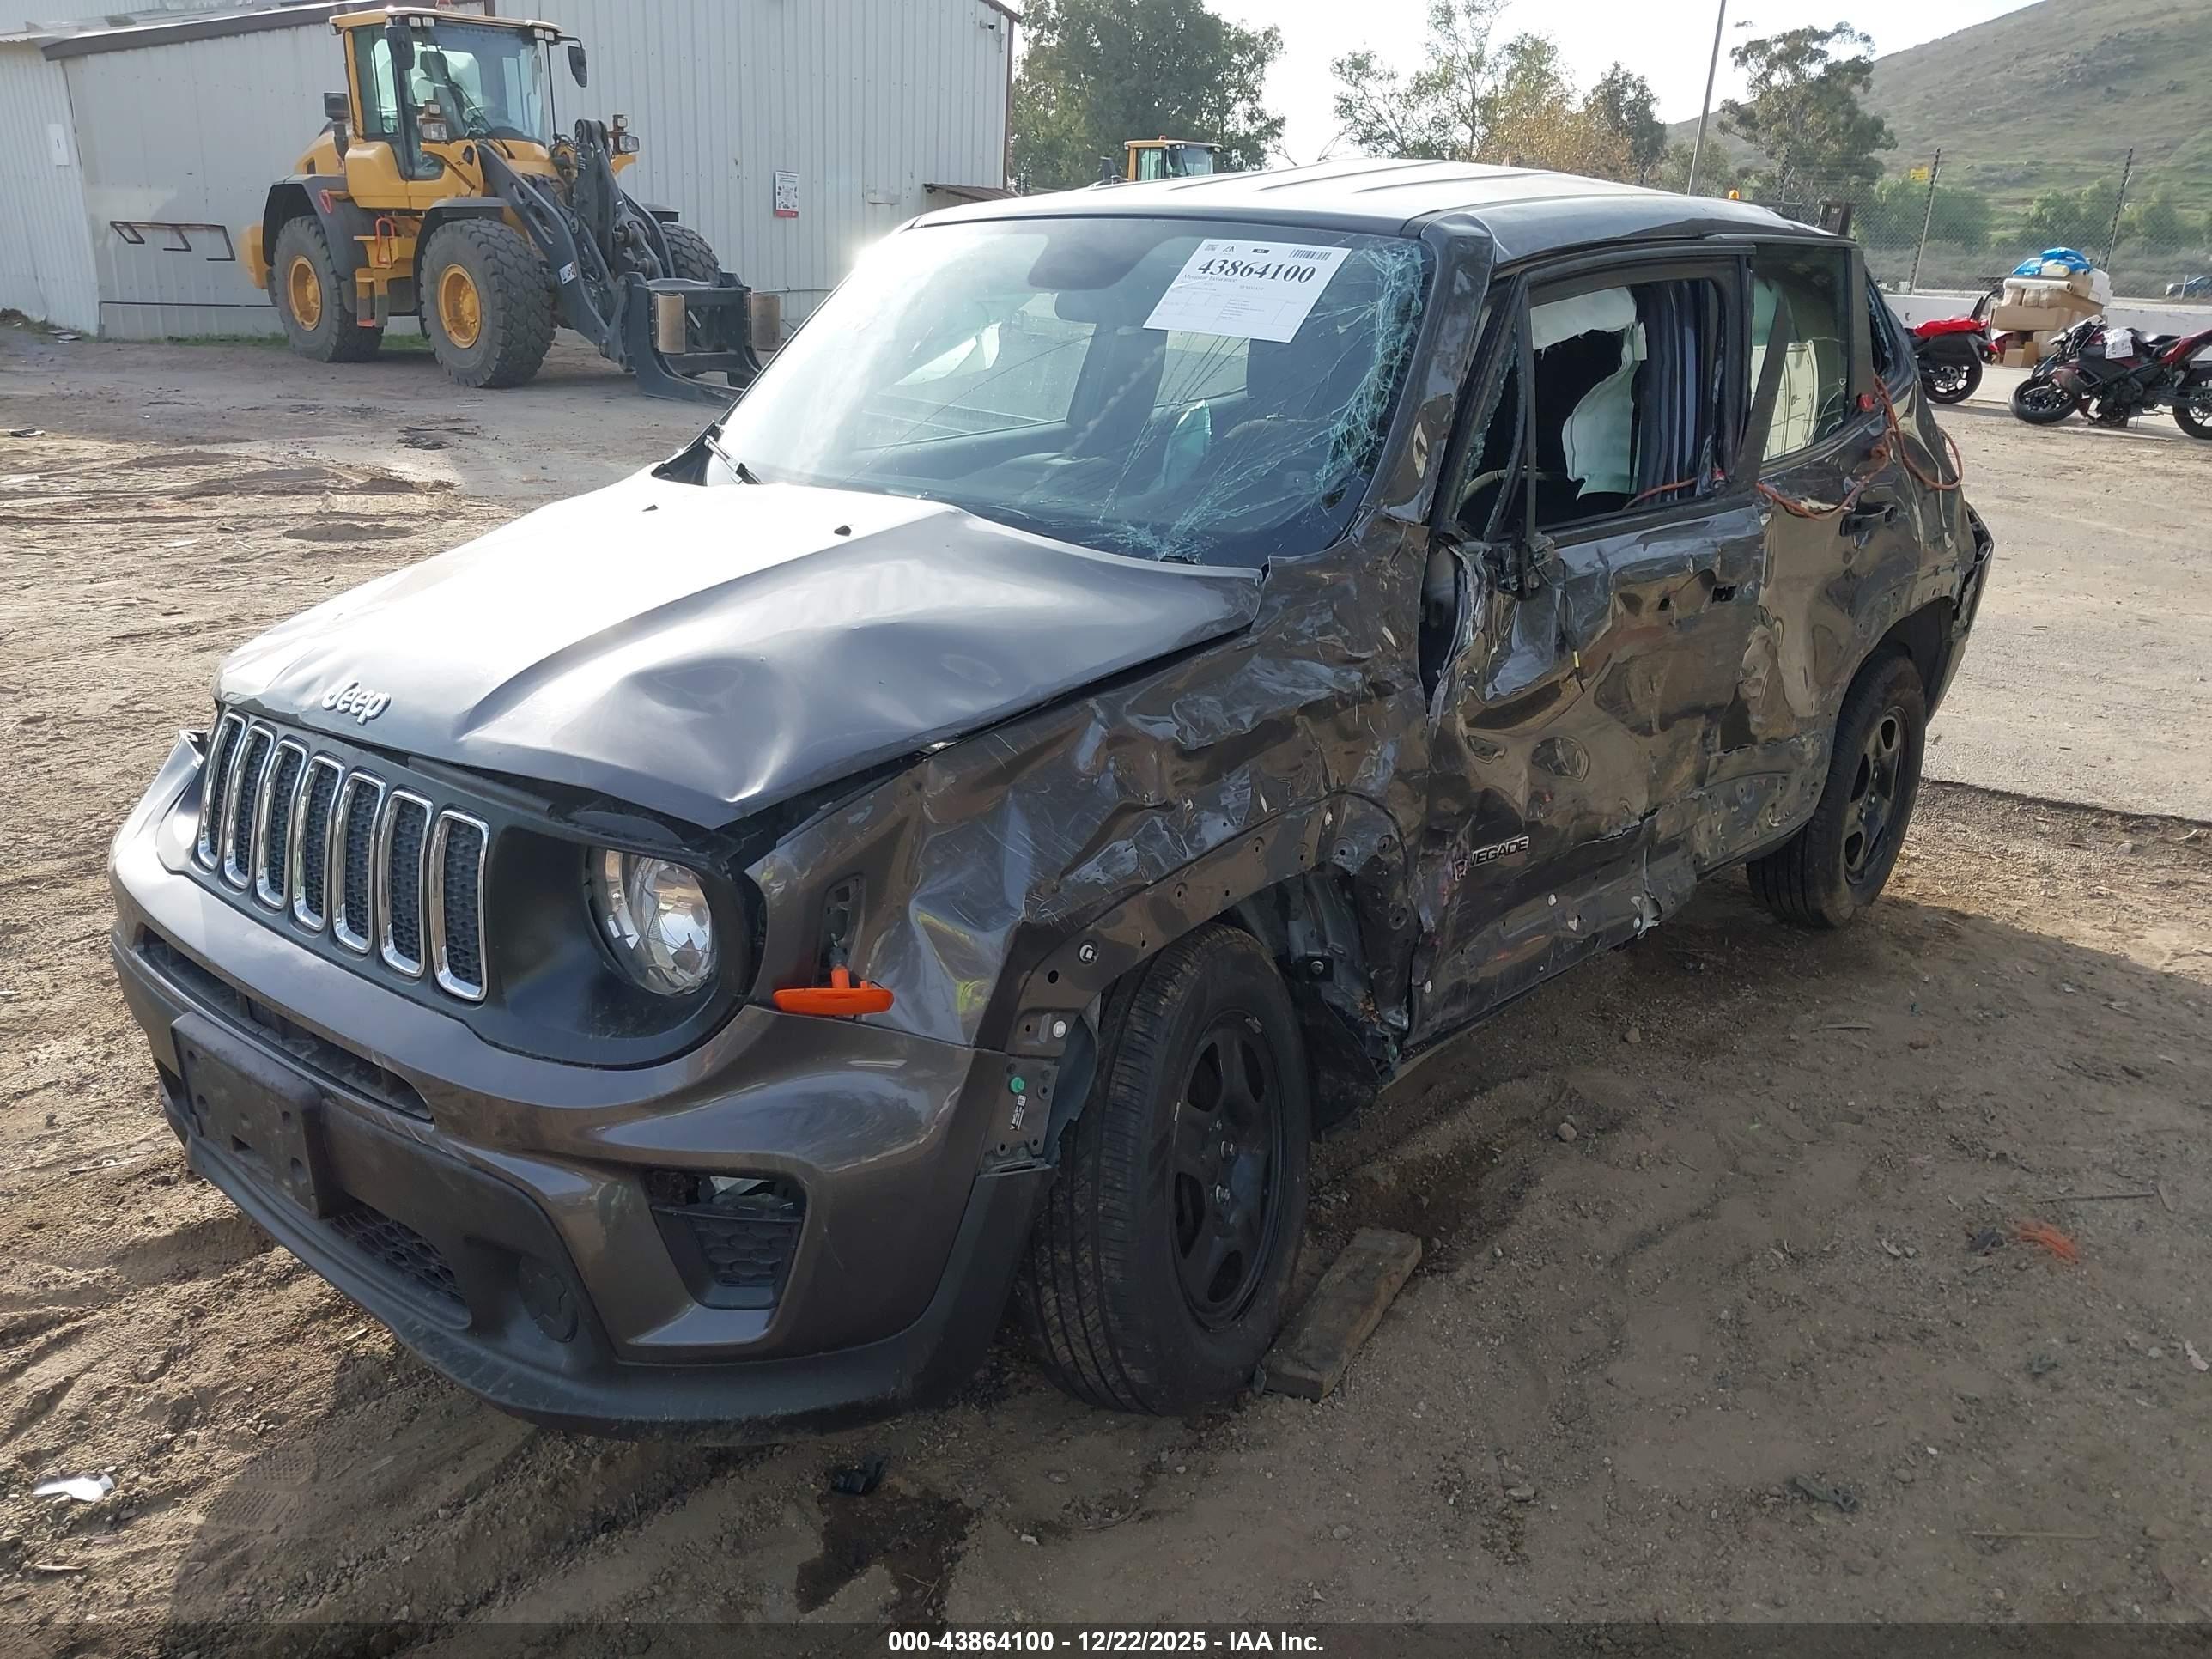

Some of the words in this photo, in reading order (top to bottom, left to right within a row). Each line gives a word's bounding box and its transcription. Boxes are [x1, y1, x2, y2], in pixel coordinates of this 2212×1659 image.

[1197, 258, 1316, 283] 43864100
[321, 680, 392, 726] Jeep
[1454, 836, 1530, 882] REGADE
